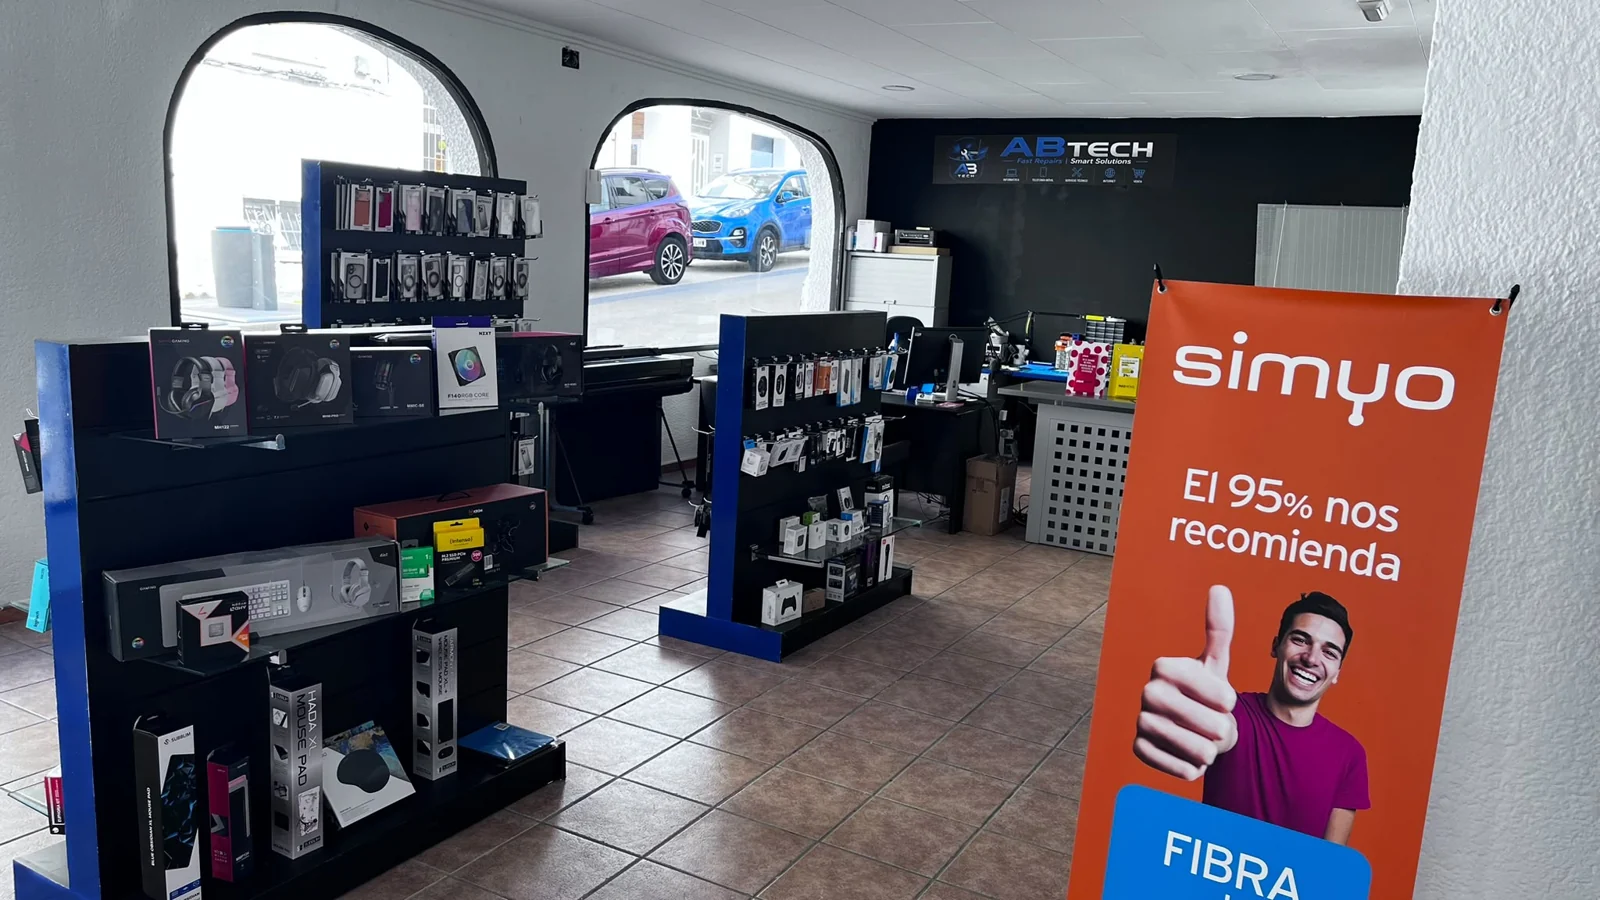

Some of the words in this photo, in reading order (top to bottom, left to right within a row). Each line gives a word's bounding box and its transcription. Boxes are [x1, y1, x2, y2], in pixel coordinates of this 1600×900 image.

[1172, 330, 1456, 427] simyo
[1183, 468, 1218, 504] El
[1228, 474, 1312, 520] 95%
[1324, 496, 1400, 533] nos
[1169, 515, 1401, 582] recomienda
[171, 732, 191, 742] SUBBLIM
[297, 693, 307, 752] MOUSE
[308, 690, 317, 732] HADA
[298, 755, 307, 787] PAD
[308, 735, 317, 756] XL
[1162, 830, 1300, 900] FIBRA
